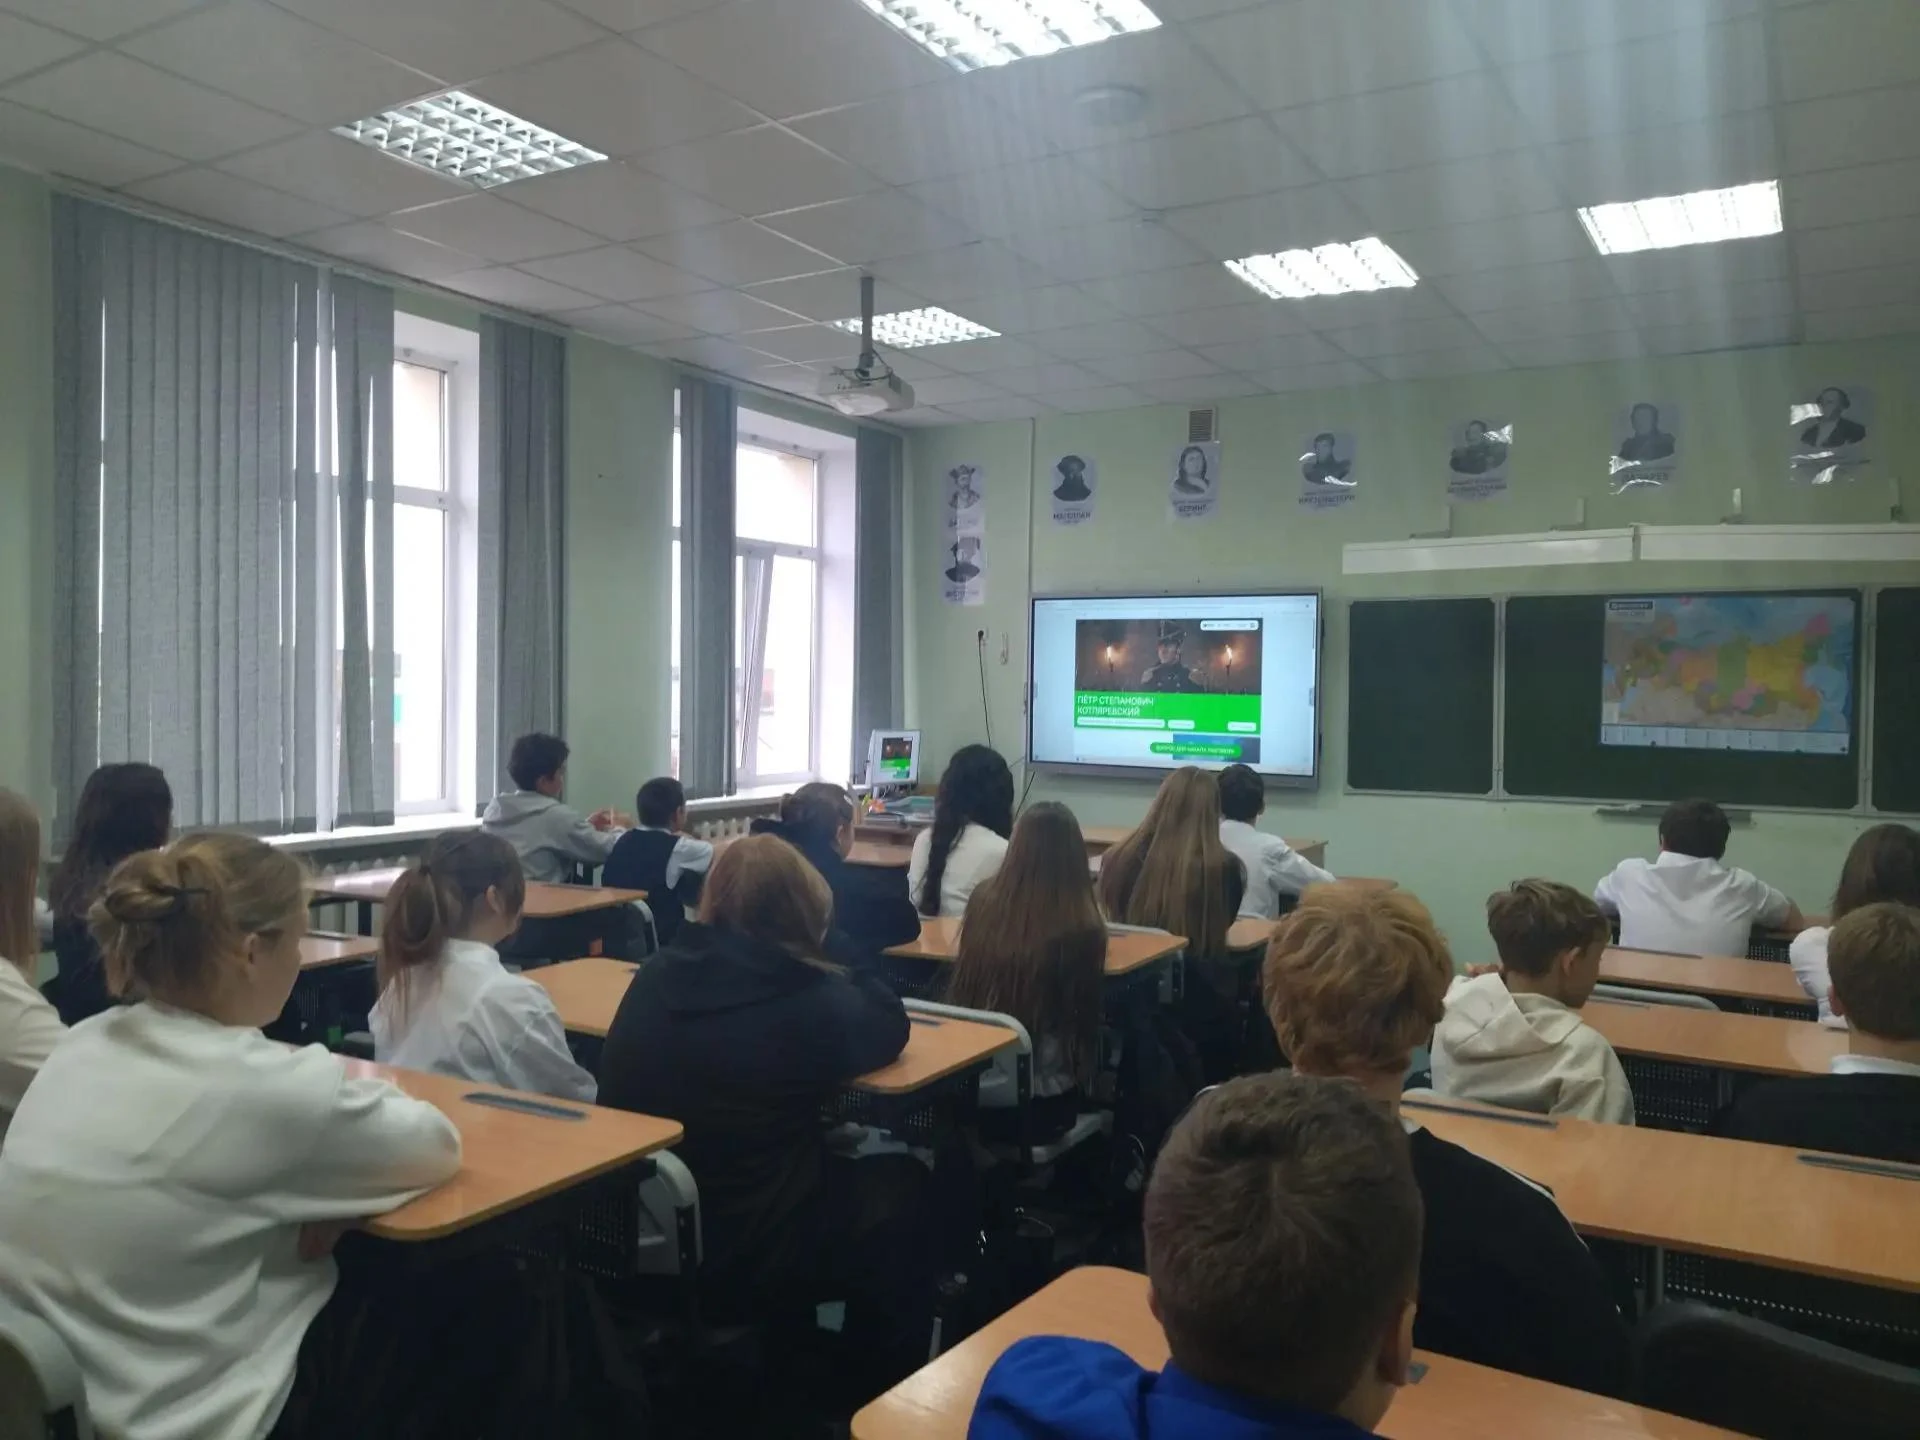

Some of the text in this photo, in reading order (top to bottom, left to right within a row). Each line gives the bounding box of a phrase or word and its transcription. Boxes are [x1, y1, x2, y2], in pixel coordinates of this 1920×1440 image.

[1077, 693, 1154, 706] ПЁТР СТЕПАНОВИЧ
[1077, 705, 1140, 716] КОТЛЯРЕВСКИЙ
